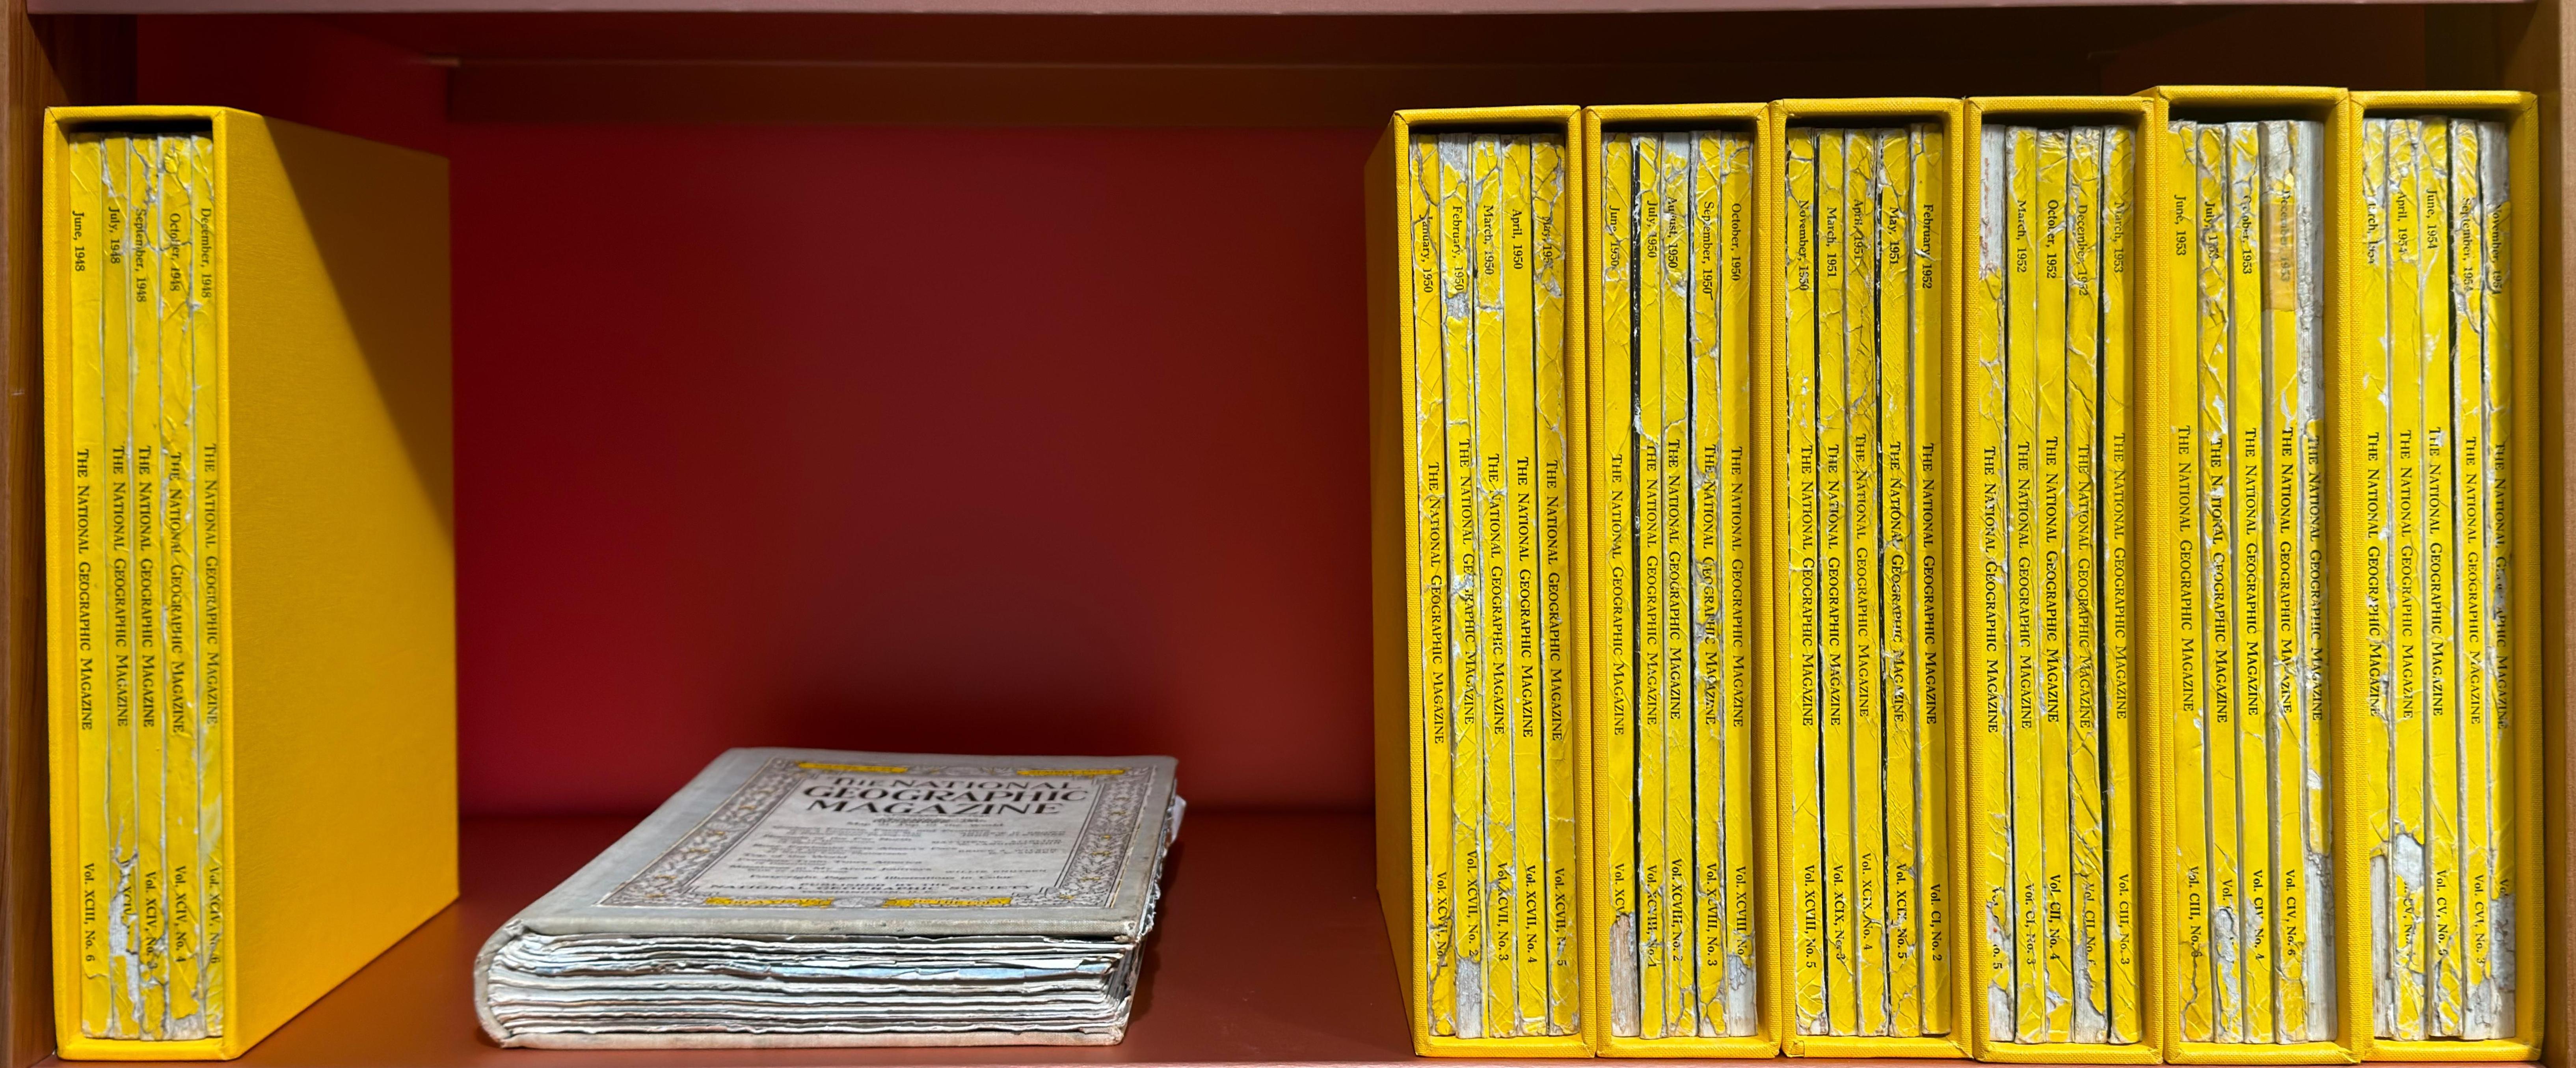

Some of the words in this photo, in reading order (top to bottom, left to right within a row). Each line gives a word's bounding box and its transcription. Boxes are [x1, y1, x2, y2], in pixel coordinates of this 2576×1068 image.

[1646, 200, 1657, 227] July,
[1852, 199, 1863, 229] April,
[2174, 195, 2187, 225] June,
[2396, 192, 2408, 222] April,
[2425, 189, 2438, 219] June,
[72, 211, 85, 240] June,
[108, 207, 120, 233] July,
[1452, 206, 1463, 259] February,
[1483, 205, 1494, 244] March,
[1511, 209, 1523, 239] April,
[1730, 203, 1742, 251] October,
[1797, 199, 1809, 261] November,
[1826, 207, 1837, 247] March,
[1887, 207, 1899, 235] May,
[2016, 199, 2027, 240] March,
[2113, 202, 2125, 242] March,
[134, 209, 146, 272] September,
[199, 208, 212, 268] December,
[1419, 214, 1433, 263] January,
[1647, 234, 1657, 258] 1950
[1854, 236, 1863, 260] 1951
[2076, 205, 2088, 265] December,
[2176, 230, 2187, 256] 1953
[2398, 228, 2408, 253] 1954
[2427, 224, 2438, 250] 1954
[74, 246, 85, 272] 1948
[110, 239, 120, 264] 1948
[1513, 244, 1523, 270] 1950
[1610, 241, 1620, 267] 1950
[1668, 244, 1678, 268] 1950
[1827, 253, 1837, 278] 1951
[1889, 241, 1899, 265] 1951
[2017, 247, 2027, 273] 1952
[2047, 253, 2057, 279] 1952
[2113, 248, 2124, 273] 1953
[2242, 249, 2252, 274] 1953
[1423, 268, 1433, 293] 1950
[1454, 266, 1465, 291] 1950
[1703, 269, 1712, 294] 1950
[1731, 256, 1741, 281] 1950
[1922, 263, 1932, 289] 1952
[136, 278, 147, 302] 1948
[201, 274, 212, 298] 1948
[1668, 439, 1681, 468] THE
[2017, 442, 2030, 471] THE
[2245, 428, 2256, 457] THE
[2399, 430, 2412, 459] THE
[77, 449, 89, 478] THE
[139, 446, 152, 475] THE
[1517, 456, 1529, 485] THE
[1731, 446, 1743, 475] THE
[1922, 443, 1934, 472] THE
[1668, 475, 1681, 544] NATIONAL
[1922, 479, 1935, 548] NATIONAL
[2018, 479, 2031, 549] NATIONAL
[2245, 465, 2257, 535] NATIONAL
[2400, 467, 2413, 537] NATIONAL
[77, 485, 90, 554] NATIONAL
[139, 482, 153, 551] NATIONAL
[1518, 493, 1530, 562] NATIONAL
[1731, 483, 1743, 551] NATIONAL
[1668, 551, 1682, 640] GEOGRAPHIC
[1923, 555, 1936, 645] GEOGRAPHIC
[2019, 557, 2031, 648] GEOGRAPHIC
[2245, 543, 2258, 634] GEOGRAPHIC
[2401, 546, 2414, 637] GEOGRAPHIC
[78, 562, 91, 651] GEOGRAPHIC
[140, 559, 154, 648] GEOGRAPHIC
[1519, 569, 1533, 658] GEOGRAPHIC
[1731, 559, 1744, 648] GEOGRAPHIC
[141, 654, 155, 728] MAGAZINE
[1669, 647, 1682, 719] MAGAZINE
[1732, 655, 1745, 727] MAGAZINE
[1924, 652, 1937, 725] MAGAZINE
[2020, 655, 2033, 729] MAGAZINE
[2247, 641, 2259, 716] MAGAZINE
[2402, 645, 2414, 719] MAGAZINE
[80, 658, 93, 730] MAGAZINE
[1521, 665, 1534, 738] MAGAZINE
[804, 785, 1089, 801] GEOGRAPHIC
[892, 779, 1081, 790] NATIONAL
[806, 799, 1063, 814] MAGAZINE
[84, 863, 95, 883] Vol.
[1467, 850, 1477, 873] Vol.
[1525, 865, 1536, 887] Vol.
[1671, 859, 1682, 880] Vol.
[1804, 865, 1815, 887] Vol.
[145, 871, 156, 893] Vol.
[175, 866, 186, 887] Vol.
[2049, 874, 2061, 896] Vol.
[2118, 874, 2129, 896] Vol.
[2285, 869, 2295, 891] Vol.
[2436, 870, 2447, 892] Vol.
[84, 890, 95, 924] XCIII,
[1466, 879, 1478, 918] XCVII,
[1671, 884, 1683, 928] XCVIII,
[1930, 883, 1941, 906] Vol.
[2435, 897, 2448, 918] CV,
[145, 898, 156, 931] XCIV,
[174, 893, 186, 926] XCIV,
[1525, 891, 1536, 929] XCVII,
[1803, 890, 1816, 934] XCVIII,
[1929, 910, 1941, 928] CI,
[2049, 901, 2061, 923] CII,
[2118, 901, 2129, 928] CIII,
[2286, 896, 2297, 923] CIV,
[85, 930, 95, 950] No.
[175, 932, 186, 951] No.
[1468, 924, 1478, 944] No.
[1526, 934, 1537, 953] No.
[1672, 932, 1682, 951] No.
[1805, 938, 1816, 958] No.
[1932, 931, 1942, 951] No.
[2049, 928, 2060, 949] No.
[2120, 933, 2129, 953] No.
[2287, 926, 2297, 946] No.
[2437, 924, 2448, 944] No.
